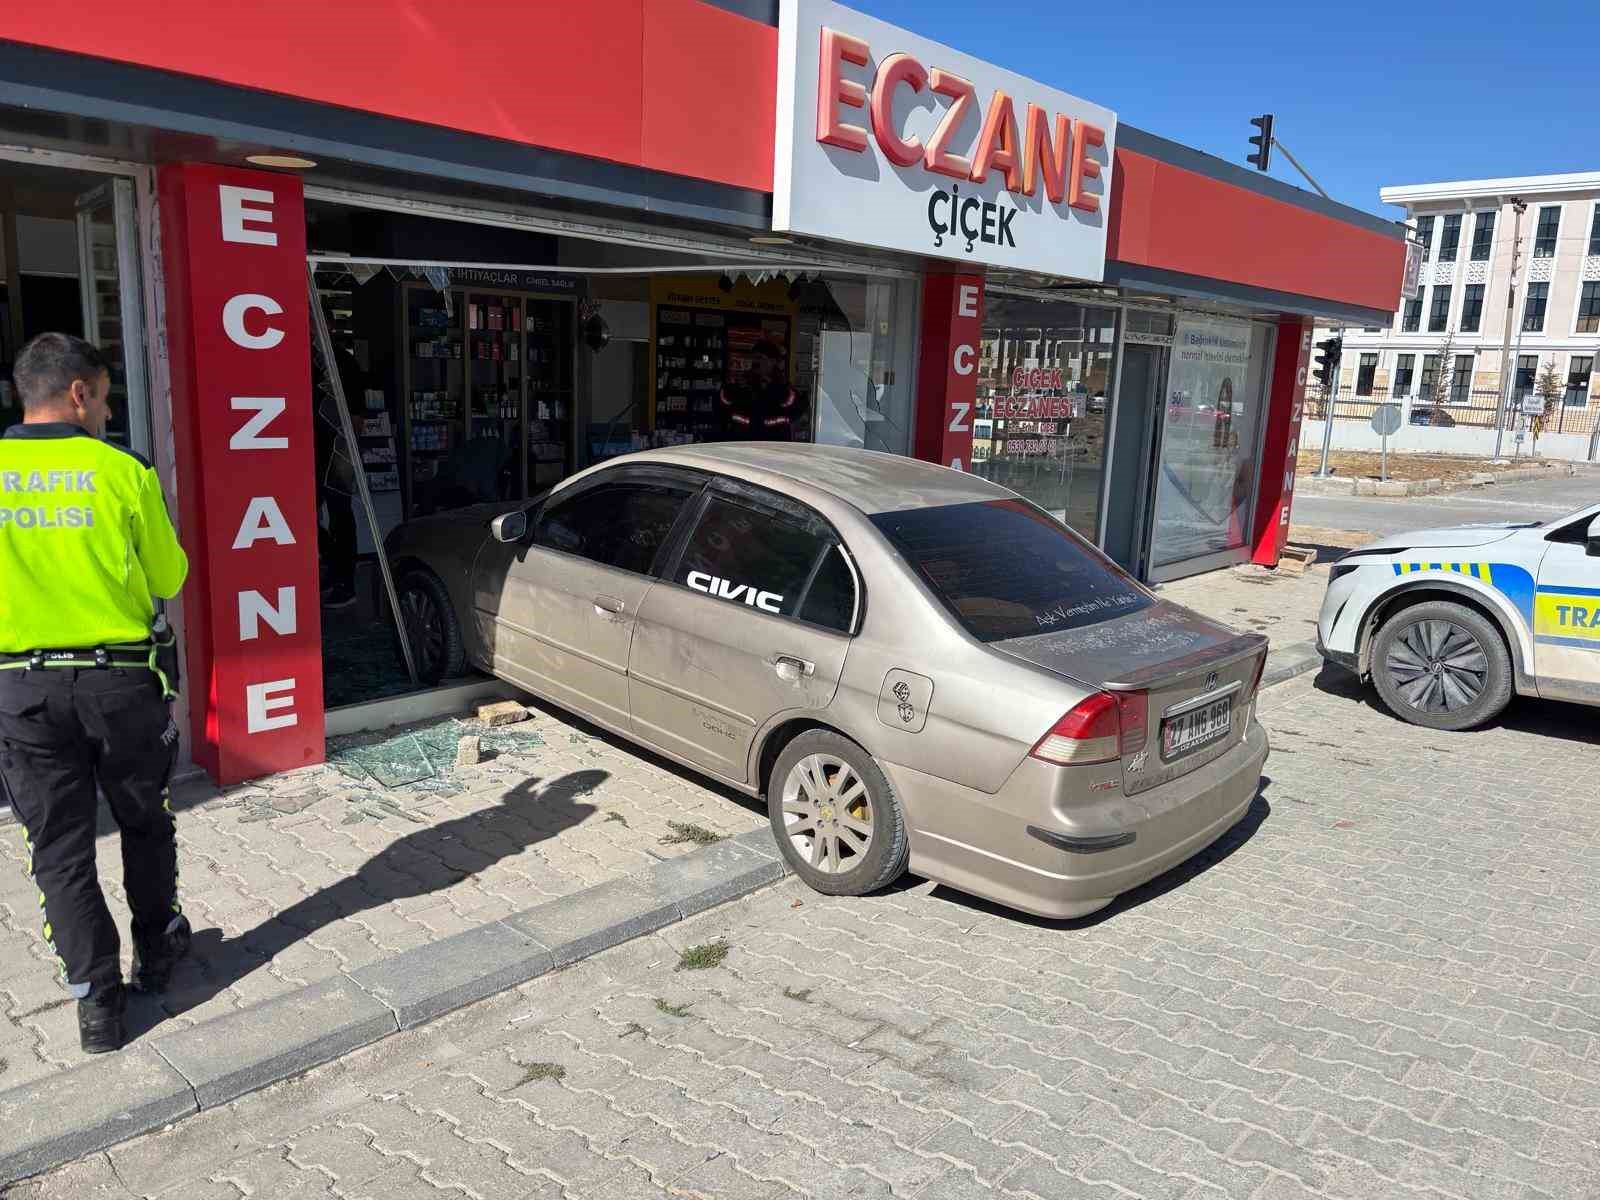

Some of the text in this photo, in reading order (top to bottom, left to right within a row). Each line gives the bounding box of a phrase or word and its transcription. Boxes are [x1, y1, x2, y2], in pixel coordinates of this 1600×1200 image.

[816, 25, 1105, 212] ECZANE
[928, 184, 1017, 253] ÇİÇEK
[219, 184, 298, 734] ECZANE
[1280, 331, 1312, 525] ECZANE
[0, 507, 94, 528] POLİSİ
[687, 571, 784, 614] CIVIC
[1210, 701, 1228, 730] 960
